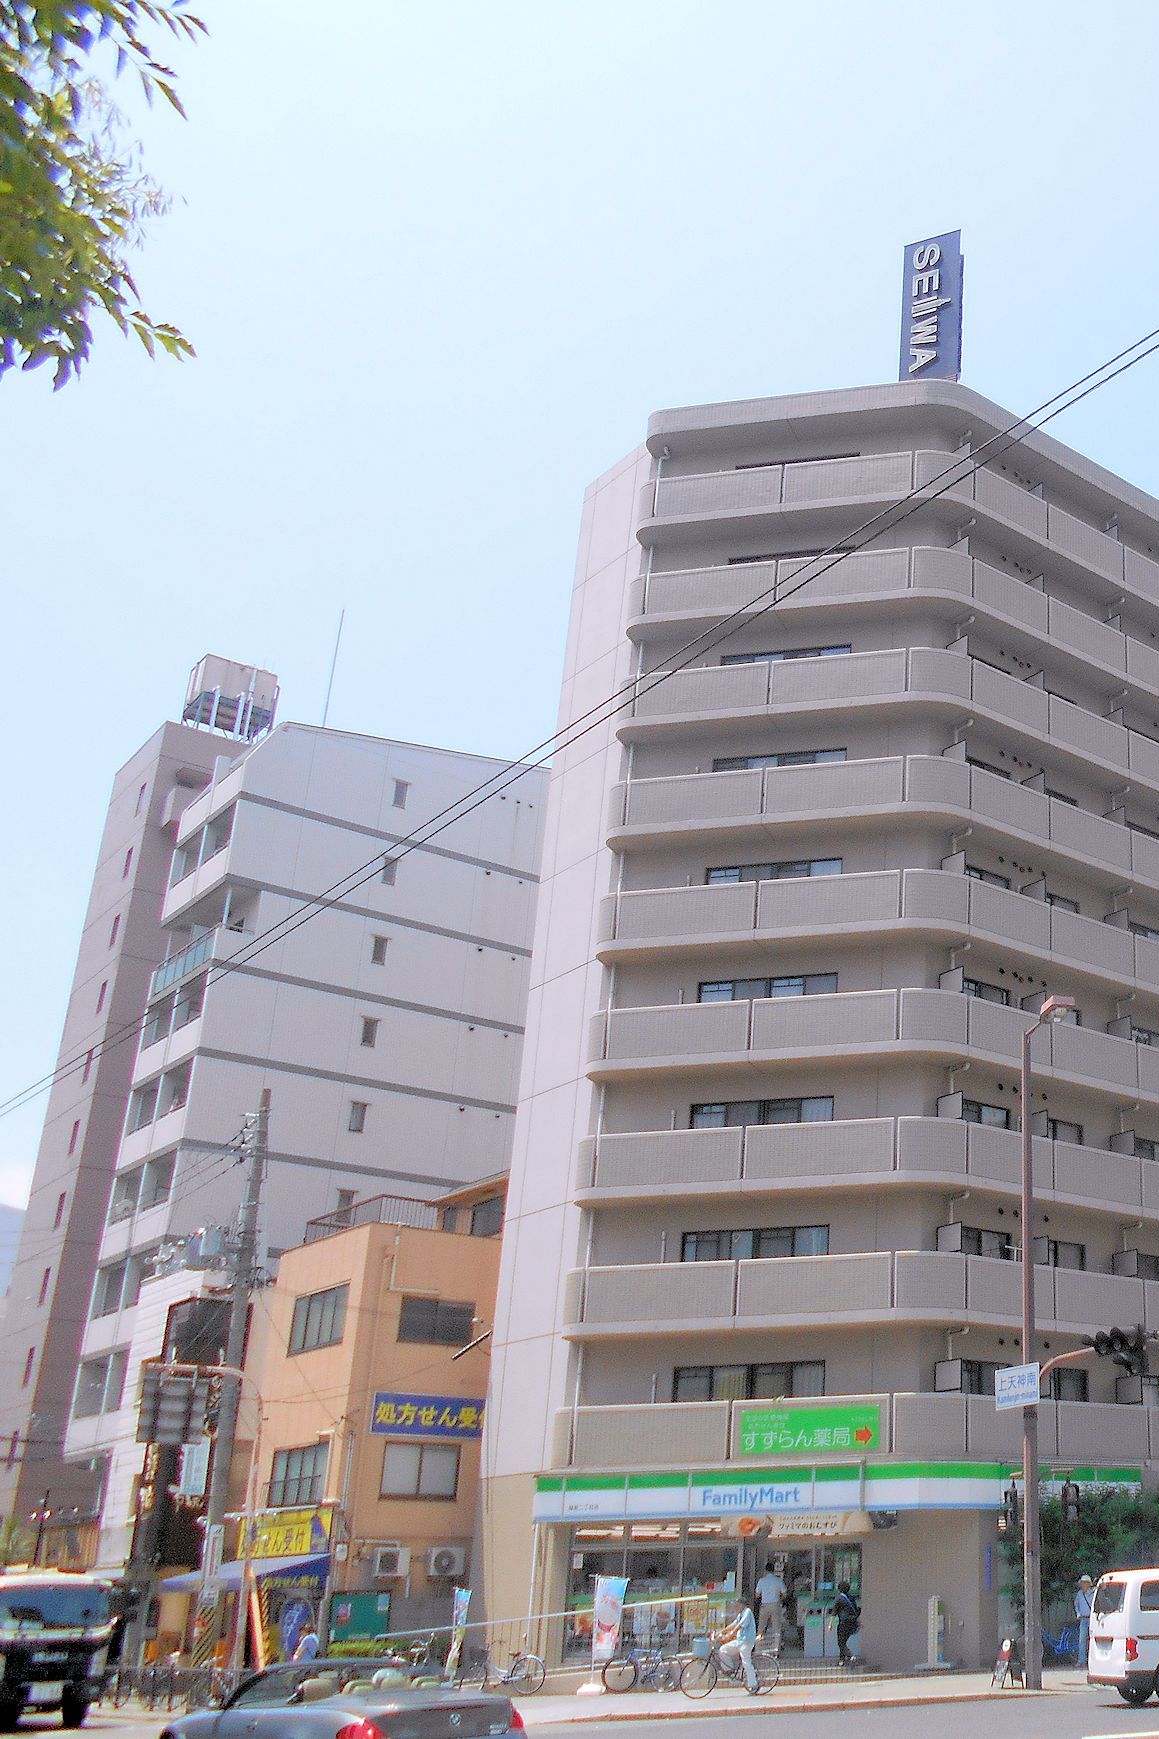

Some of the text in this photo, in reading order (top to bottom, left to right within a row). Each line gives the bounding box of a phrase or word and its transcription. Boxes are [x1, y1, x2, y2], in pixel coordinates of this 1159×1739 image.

[908, 242, 951, 373] SEIWA
[998, 1371, 1037, 1392] 上天神南
[742, 1427, 851, 1451] すずらん薬局
[702, 1485, 801, 1510] FamilyMart
